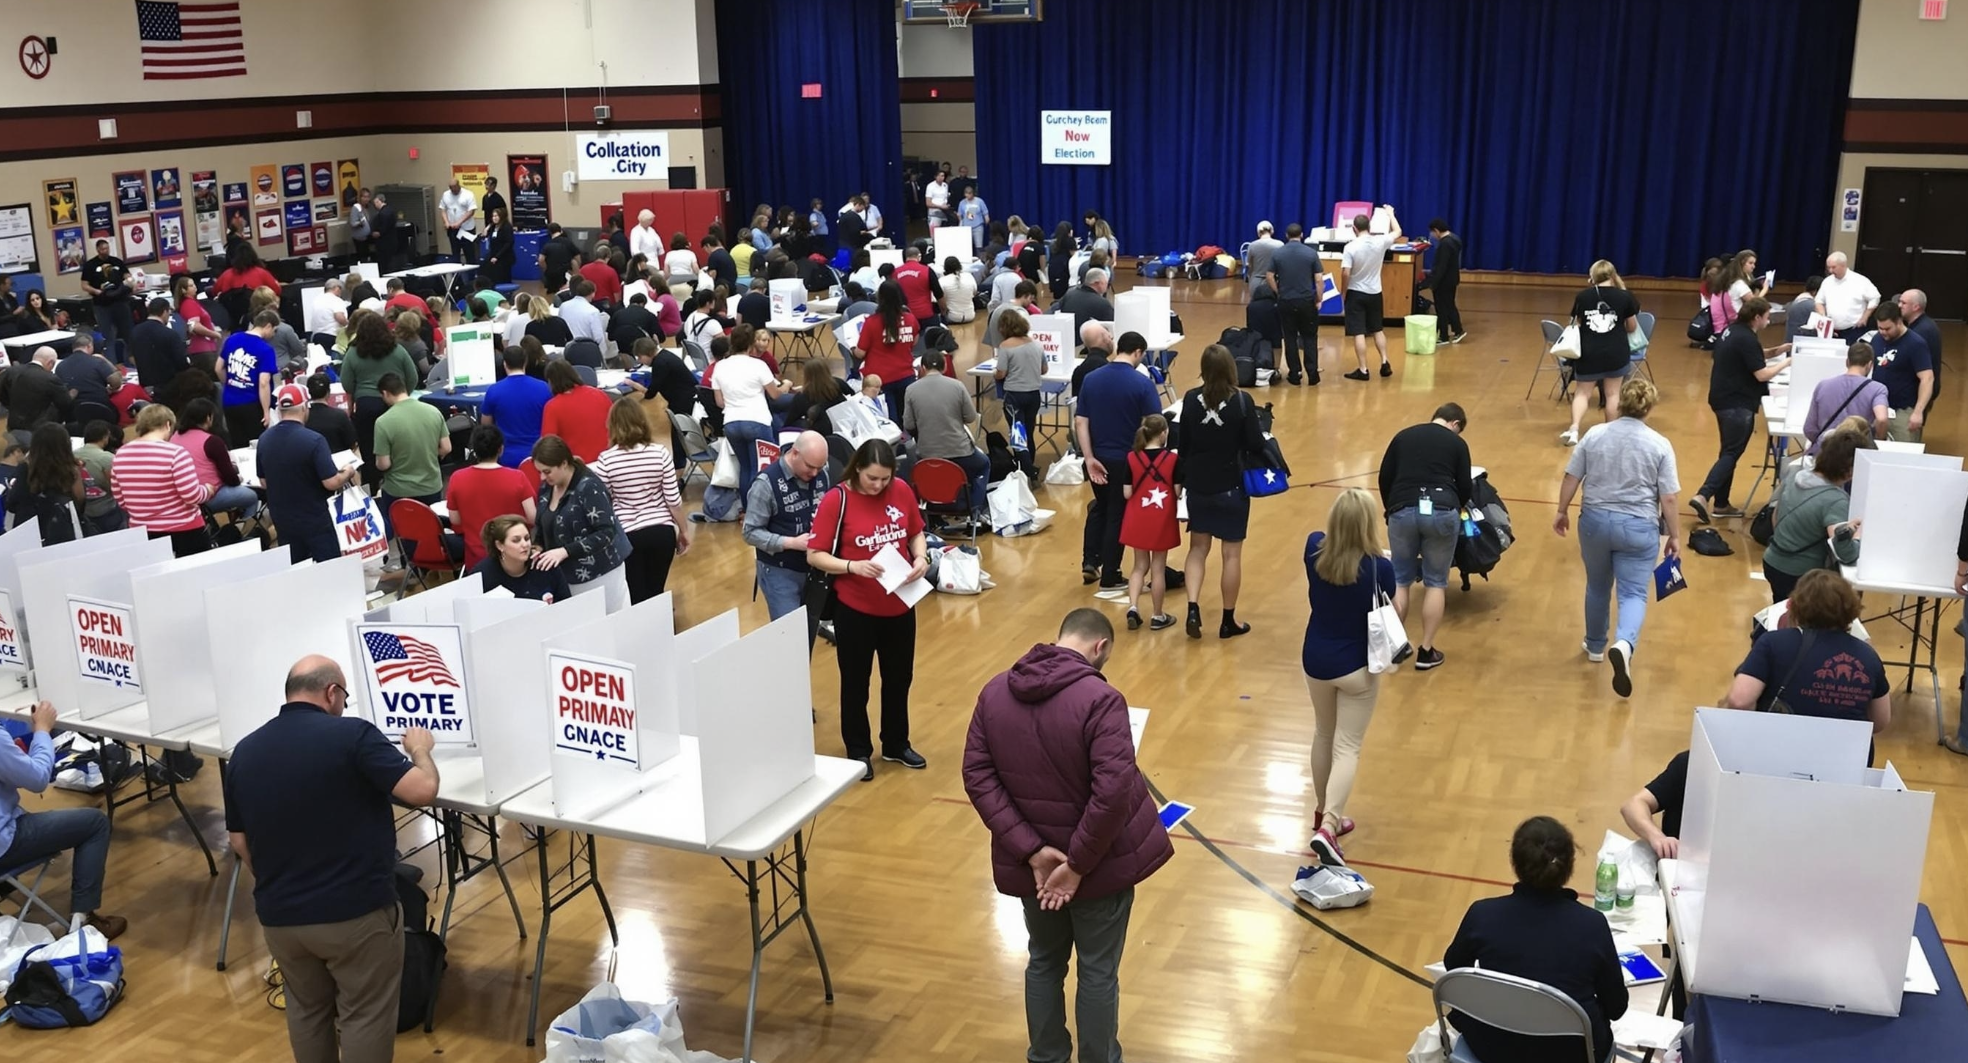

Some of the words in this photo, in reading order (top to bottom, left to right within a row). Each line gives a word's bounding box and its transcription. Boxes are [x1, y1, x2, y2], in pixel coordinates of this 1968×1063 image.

[1065, 129, 1090, 141] Now
[1055, 148, 1095, 158] Election
[1032, 333, 1052, 342] PEN
[78, 608, 122, 636] OPEN
[0, 627, 14, 642] RY
[0, 644, 17, 657] CE
[80, 635, 134, 662] PRIMARY
[562, 666, 624, 702] OPEN
[381, 691, 456, 715] VOTE
[386, 716, 463, 731] PRIMARY
[564, 724, 626, 752] GNACE
